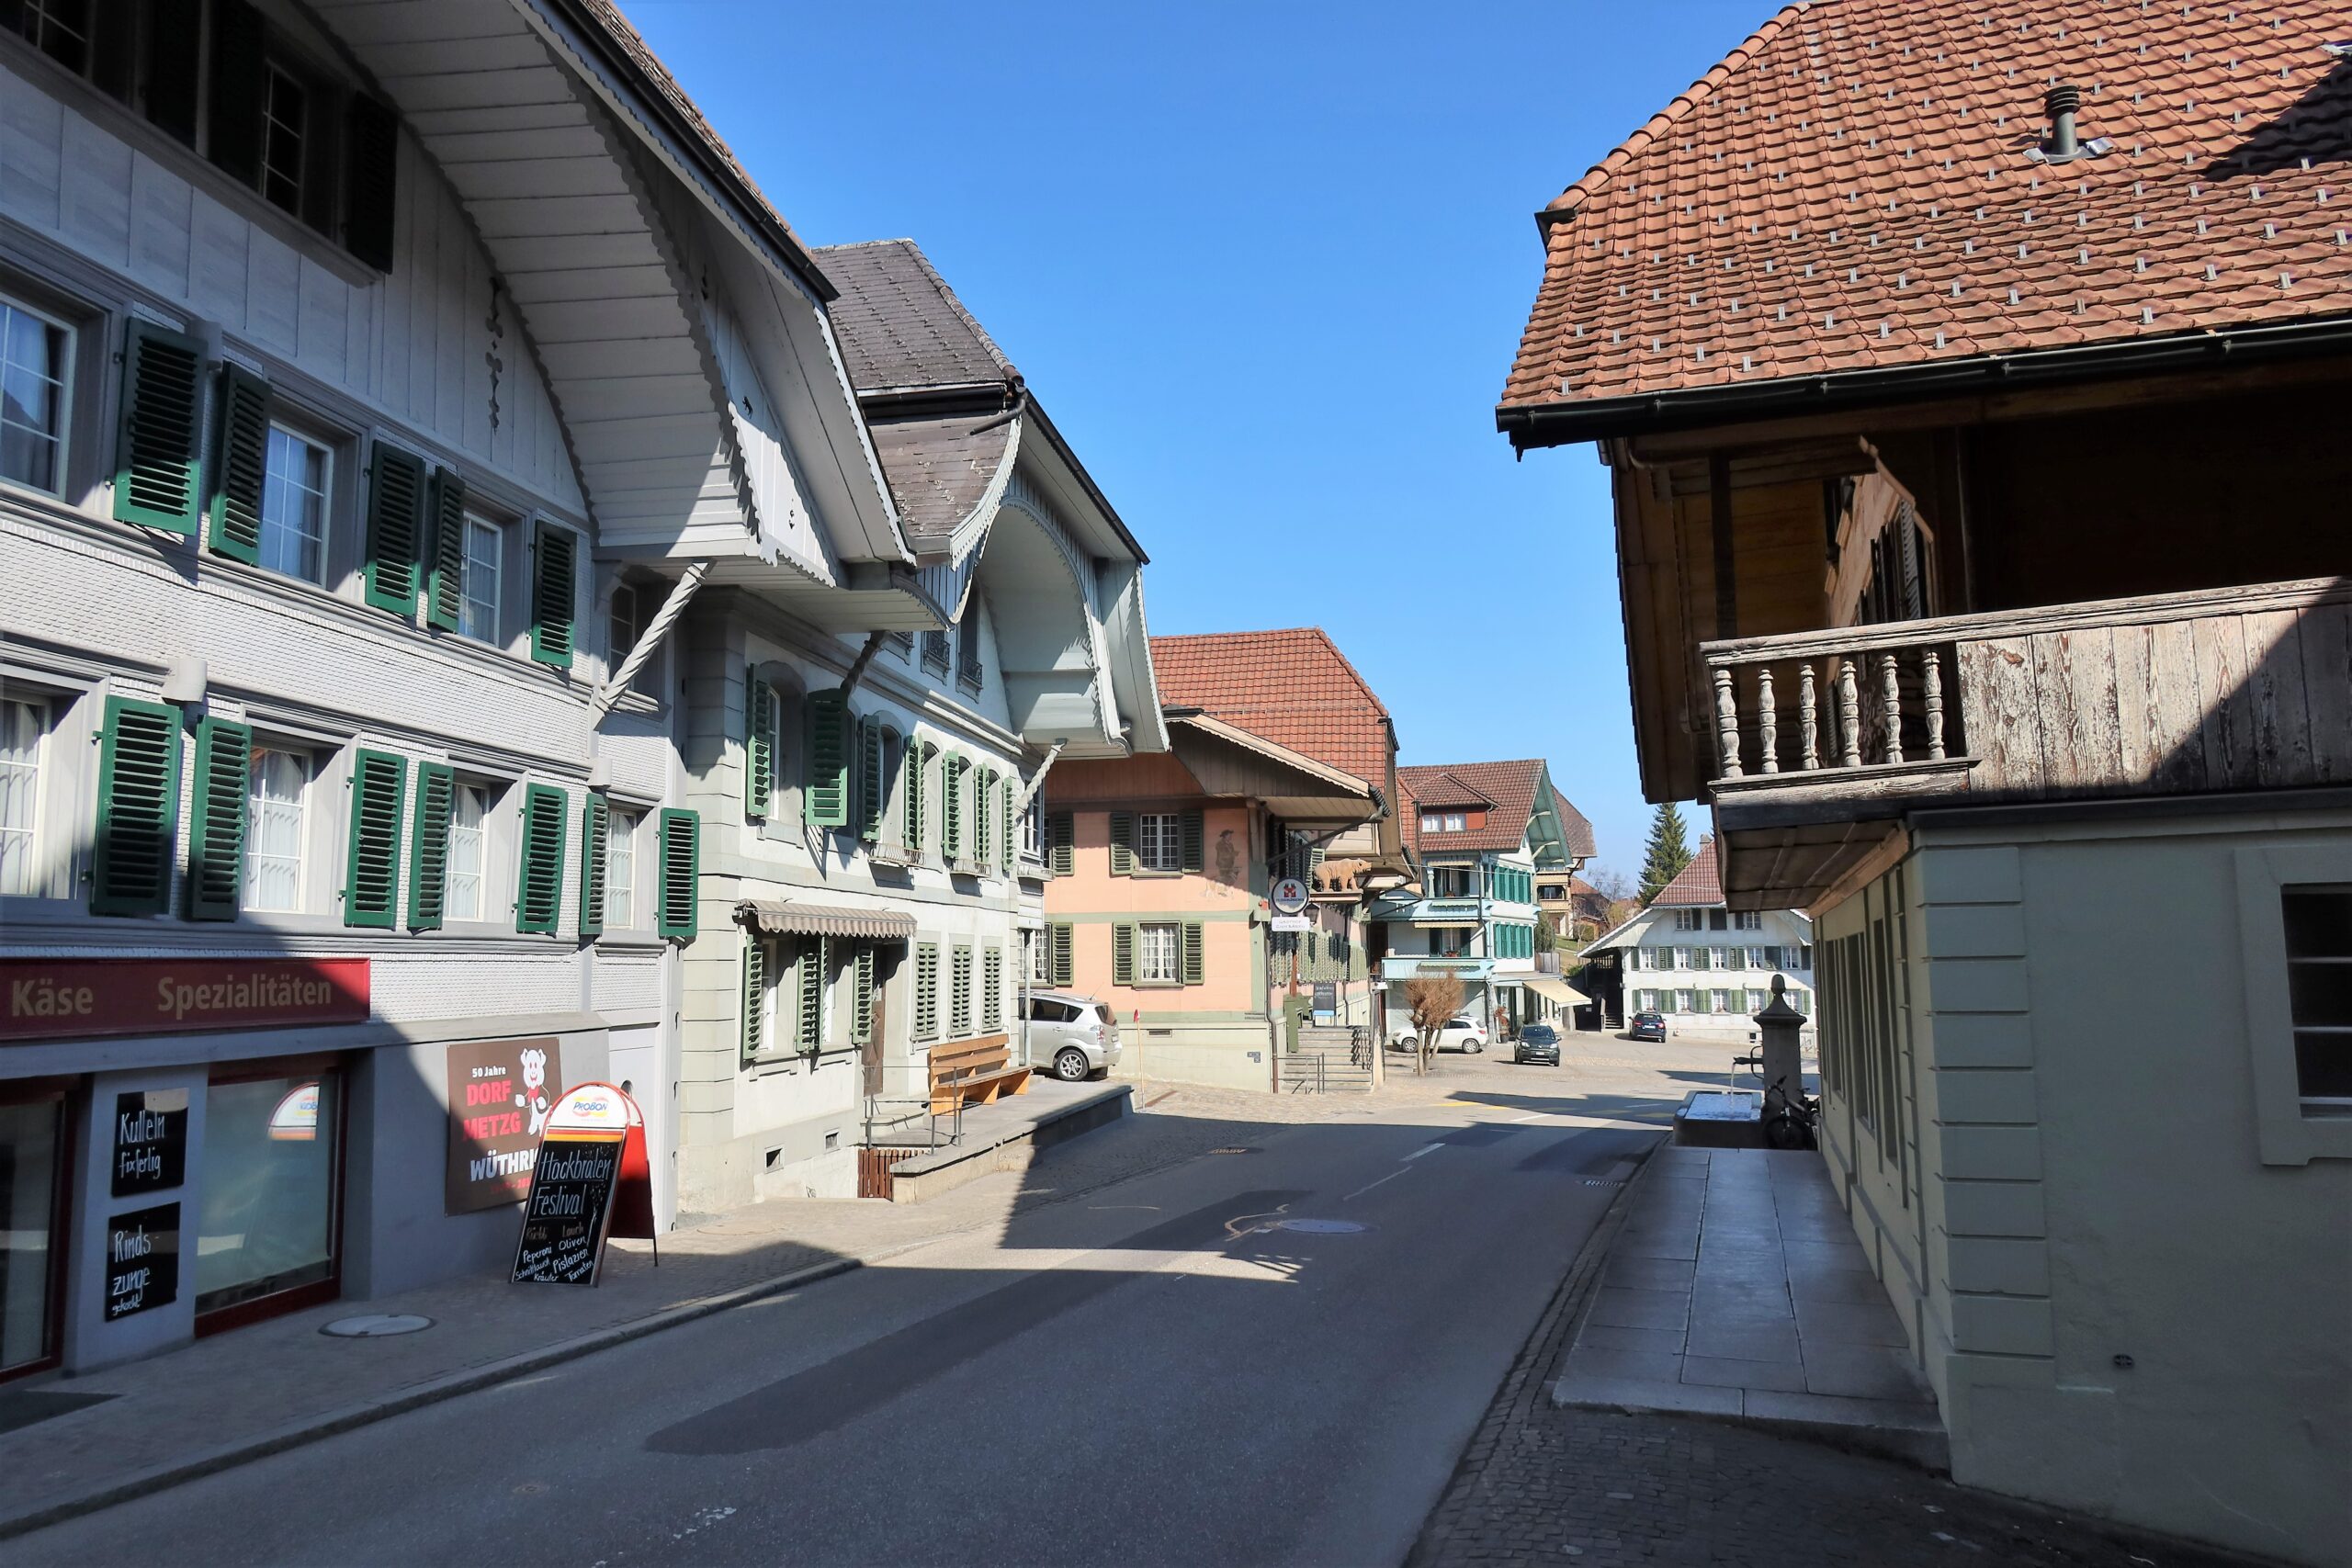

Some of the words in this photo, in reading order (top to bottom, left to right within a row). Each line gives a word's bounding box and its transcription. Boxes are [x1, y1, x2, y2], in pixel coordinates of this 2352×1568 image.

[11, 978, 93, 1018] Käse
[157, 974, 332, 1021] Spezialitäten
[471, 1067, 483, 1077] 50
[483, 1066, 506, 1077] Jahre
[467, 1080, 512, 1107] DORF
[463, 1111, 521, 1140] METZG
[559, 1236, 587, 1250] Oliven
[564, 1260, 594, 1281] Tomaten
